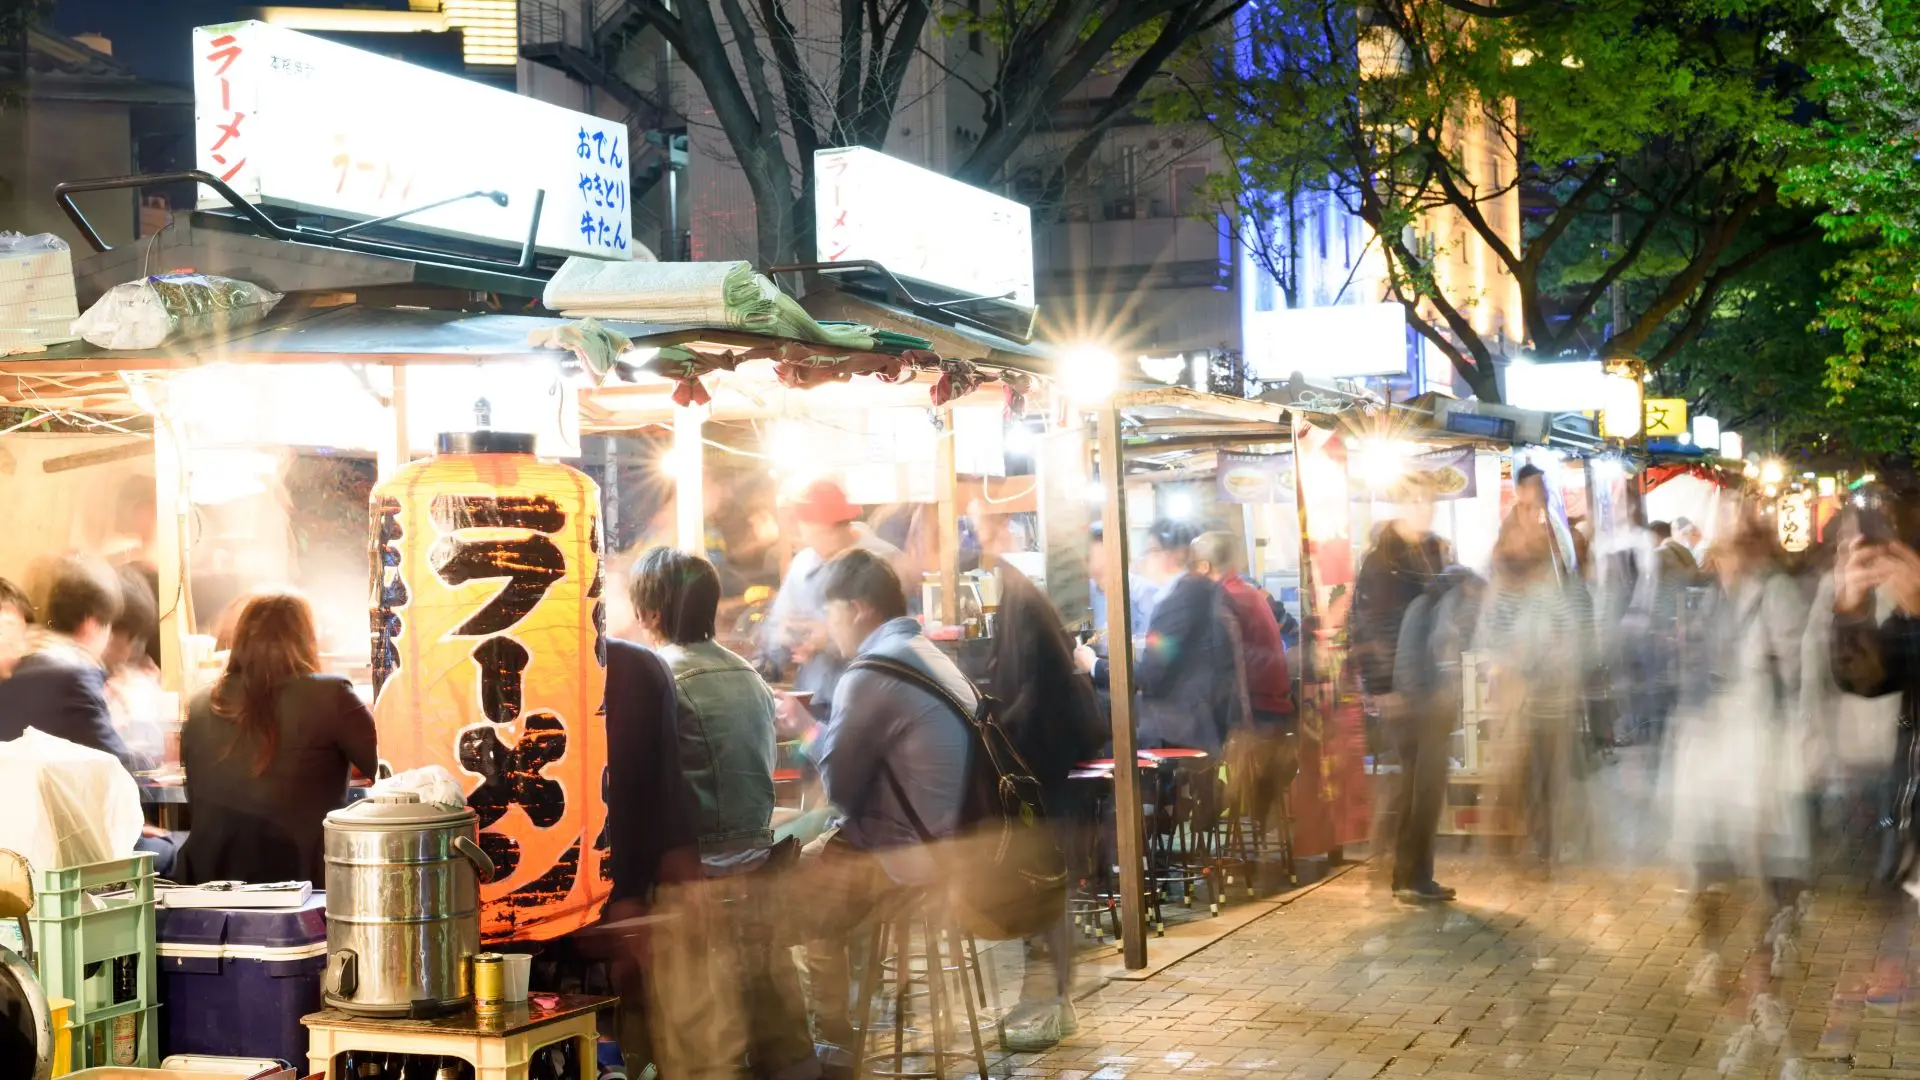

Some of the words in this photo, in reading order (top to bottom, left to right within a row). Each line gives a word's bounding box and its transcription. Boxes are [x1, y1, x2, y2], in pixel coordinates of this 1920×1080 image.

[206, 34, 247, 183] ラーメン
[577, 126, 622, 168] おでん
[579, 172, 624, 213] やきとり
[581, 210, 626, 249] 牛たん
[825, 156, 851, 262] ラーメン
[429, 496, 580, 920] ラーメン
